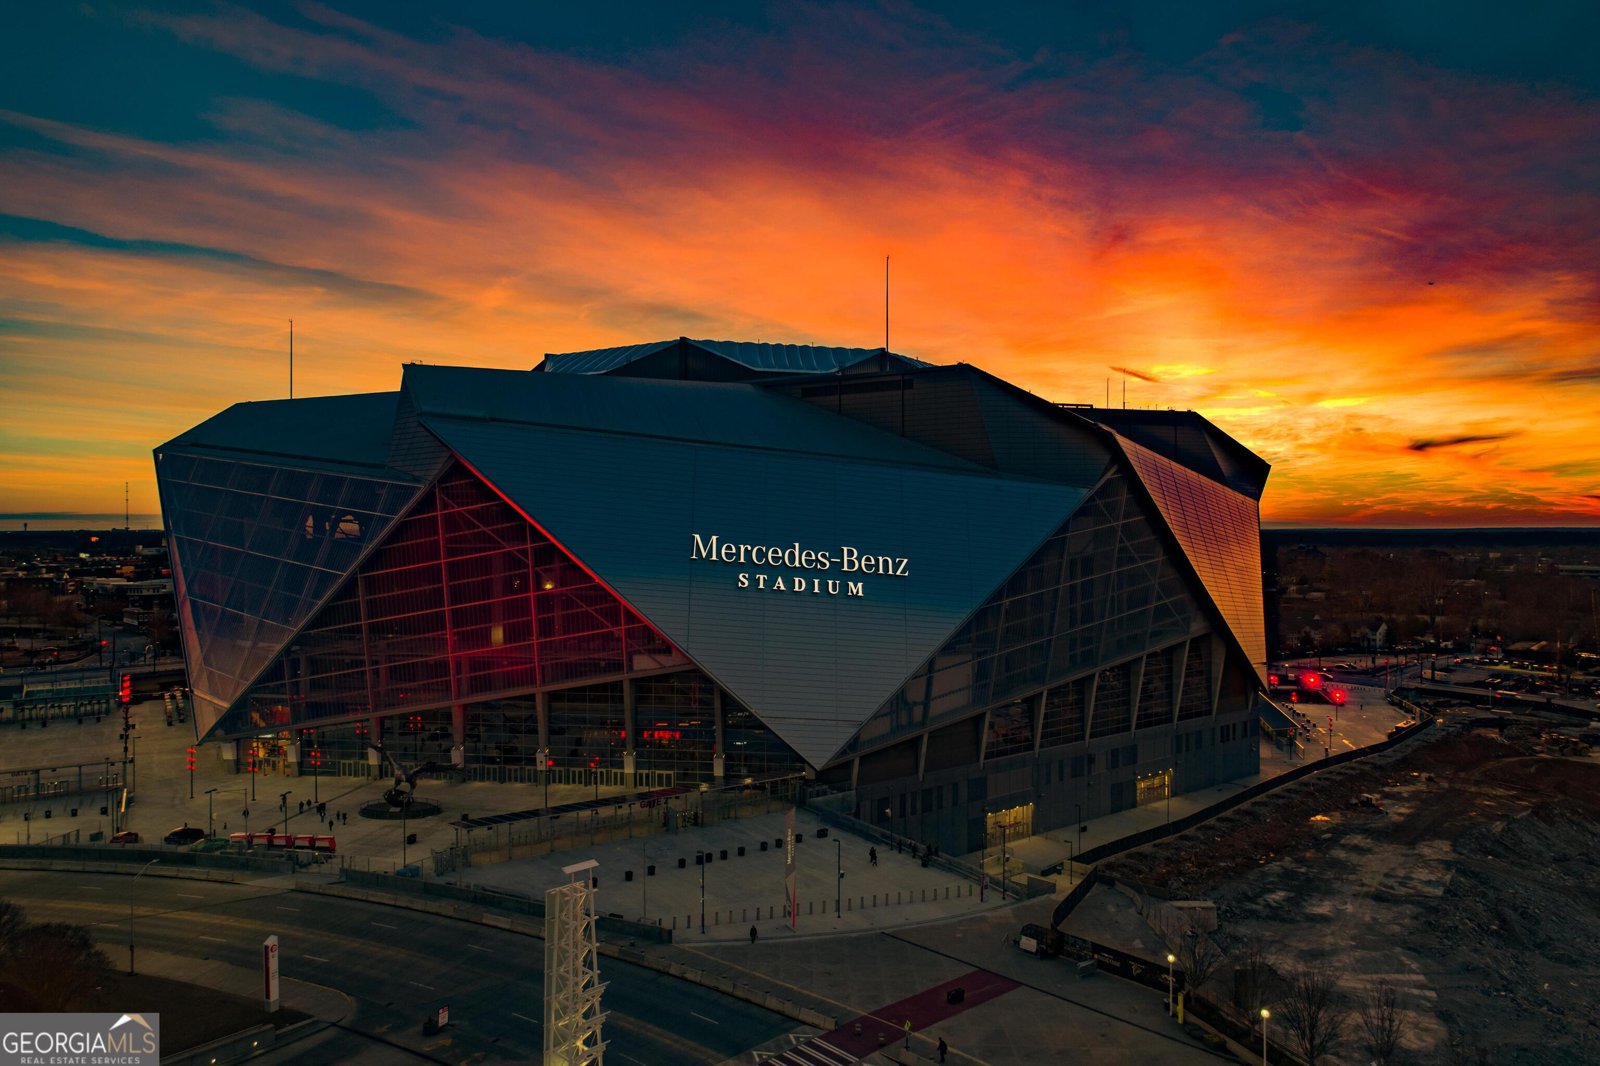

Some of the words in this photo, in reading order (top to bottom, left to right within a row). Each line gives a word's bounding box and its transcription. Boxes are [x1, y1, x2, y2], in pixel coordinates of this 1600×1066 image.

[690, 533, 910, 577] Mercedes-Benz
[738, 573, 865, 597] STADIUM
[640, 798, 662, 809] GATE
